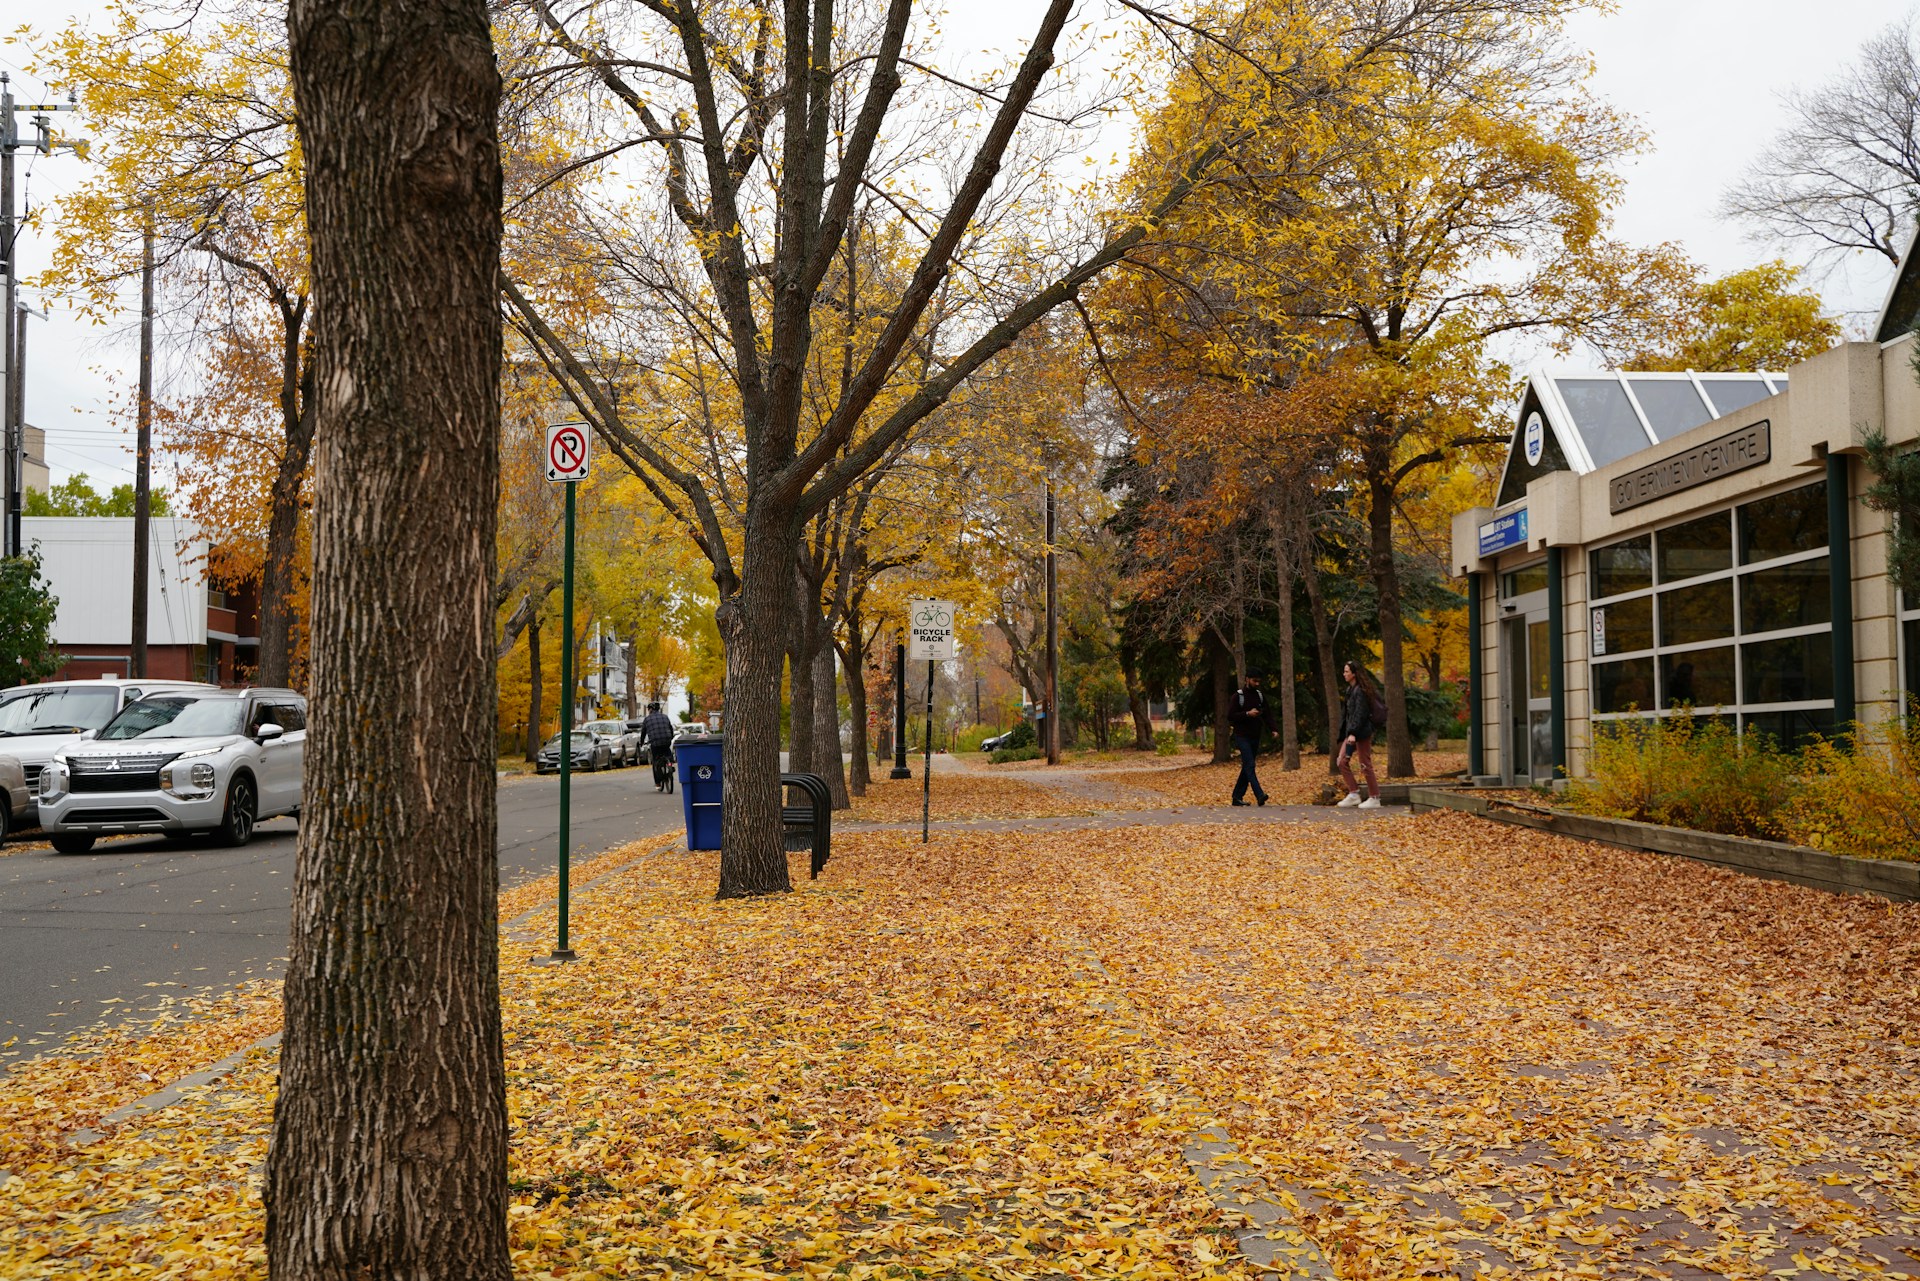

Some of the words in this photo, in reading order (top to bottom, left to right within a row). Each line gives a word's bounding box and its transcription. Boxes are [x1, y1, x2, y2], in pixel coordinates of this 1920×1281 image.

[1616, 455, 1697, 504] GOVERNMENT
[1701, 433, 1757, 474] CENTRE
[913, 628, 951, 636] BICYCLE
